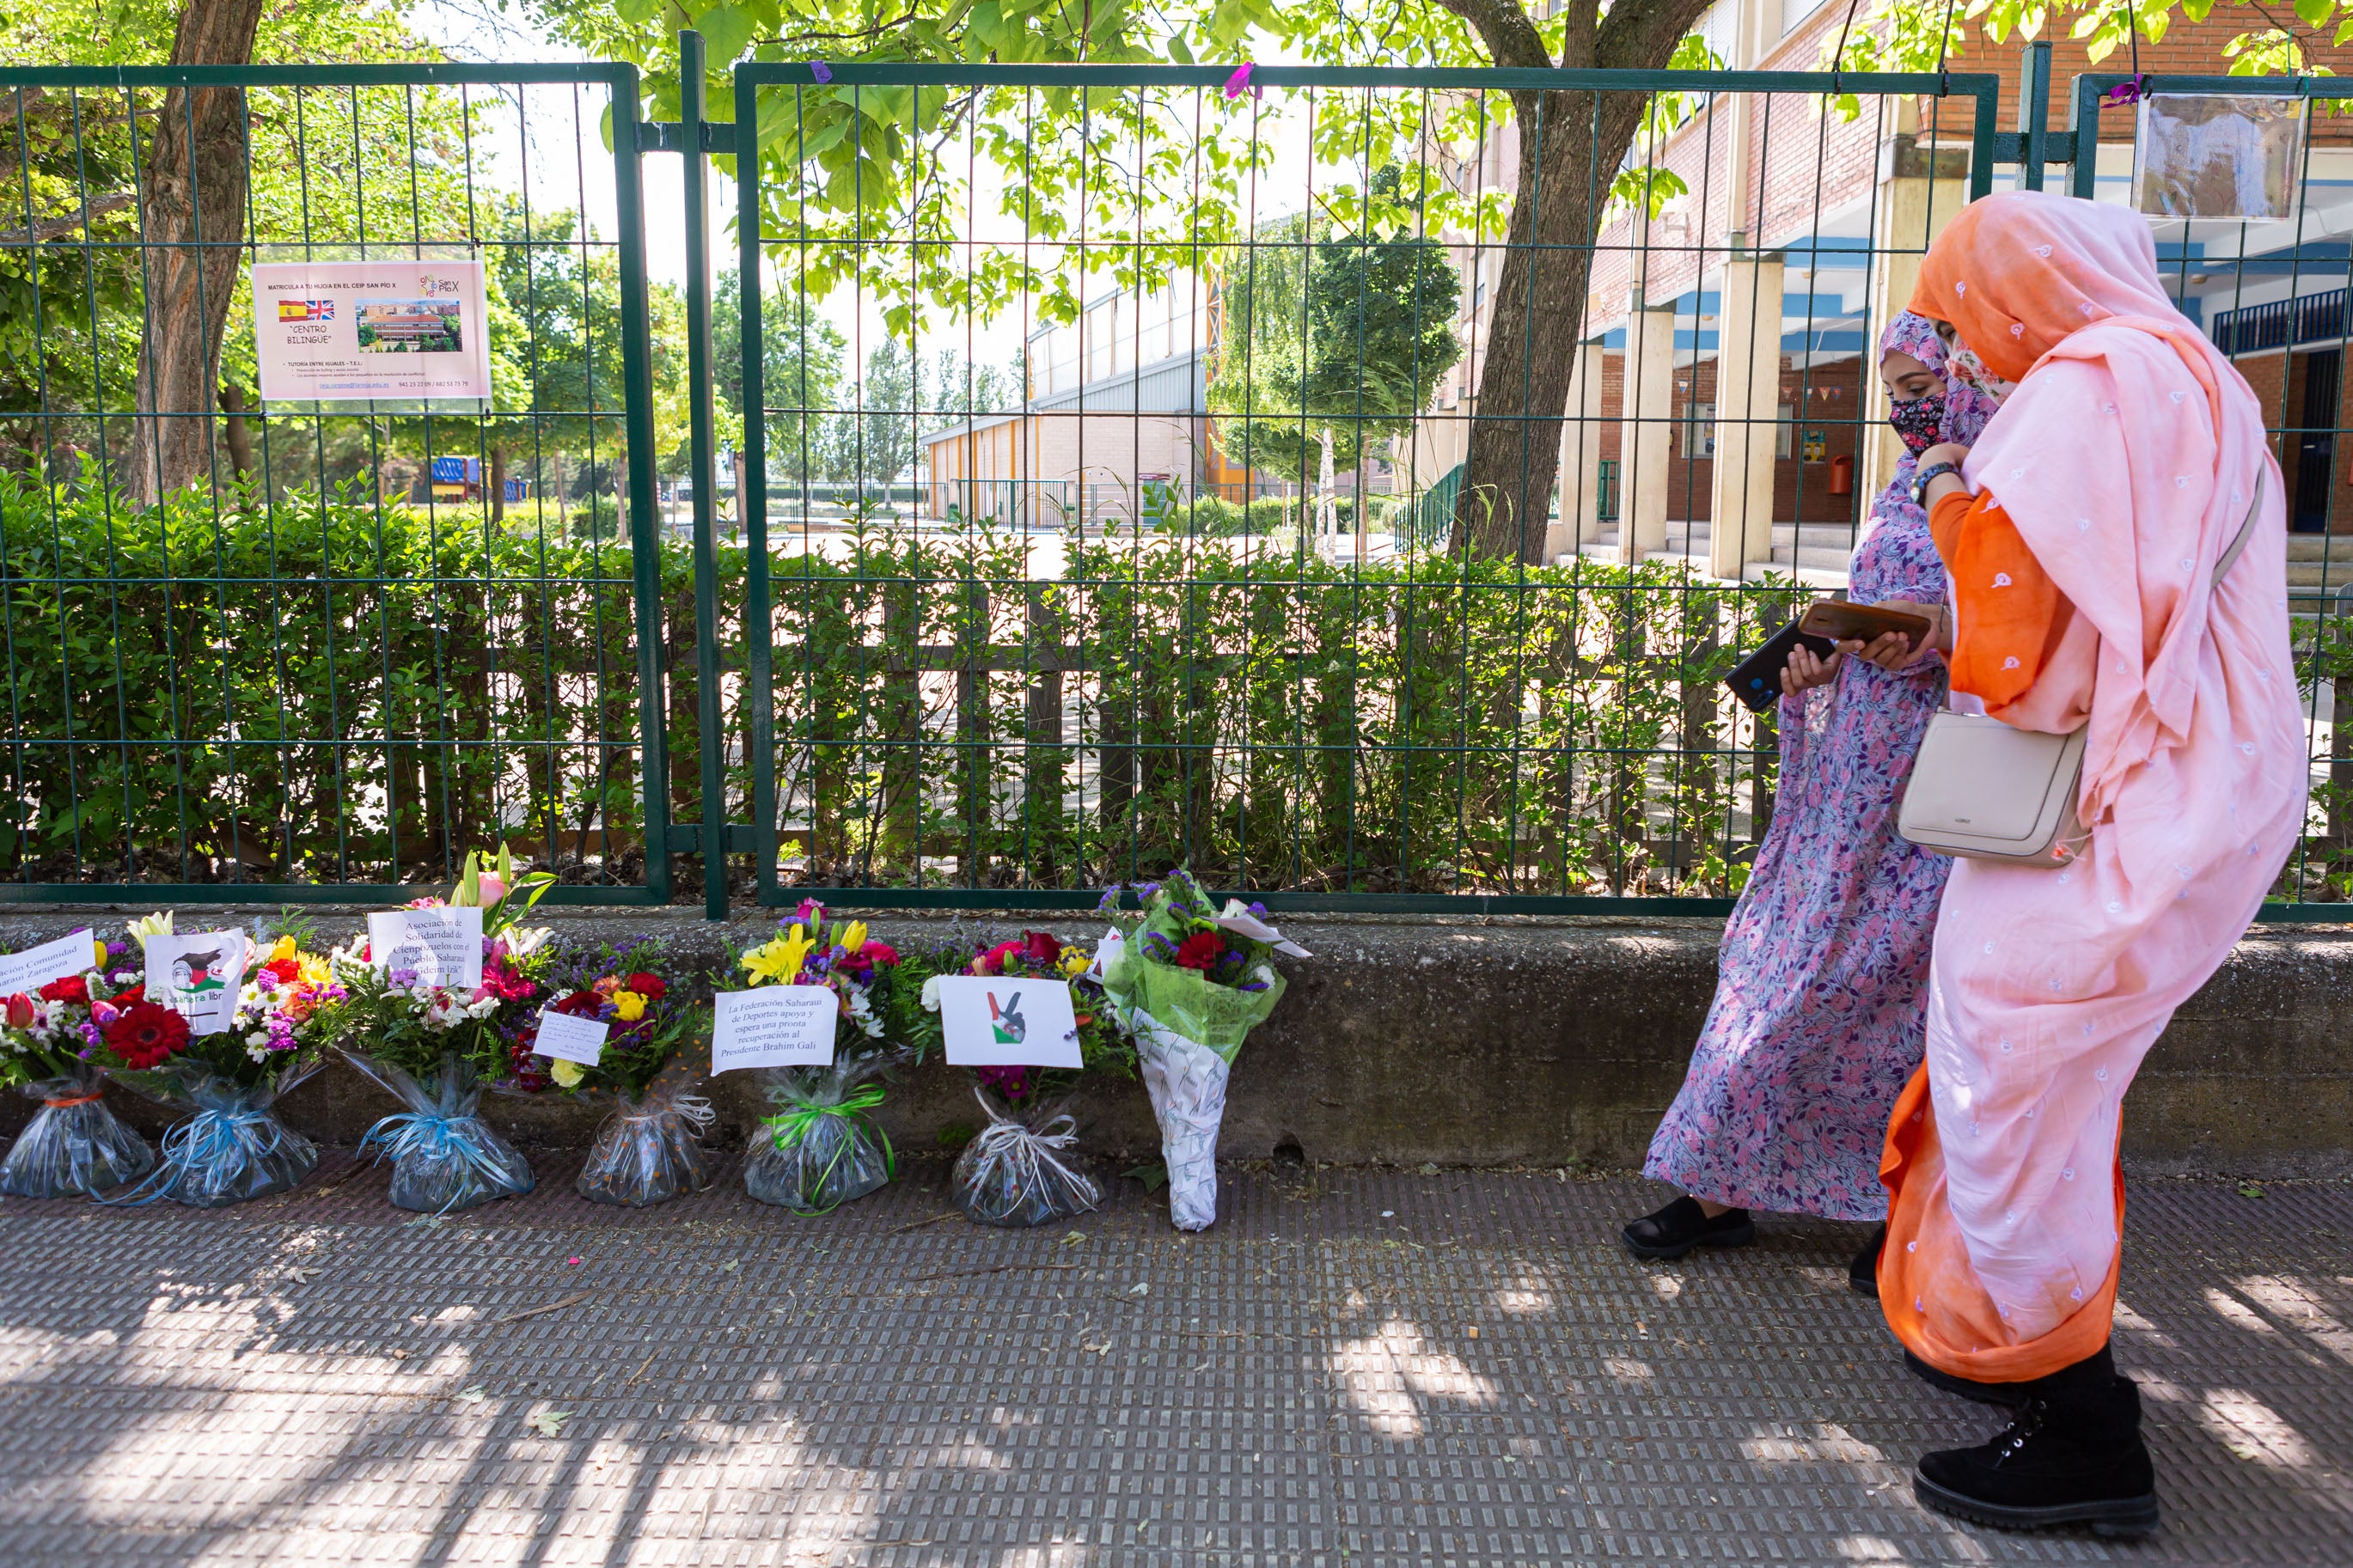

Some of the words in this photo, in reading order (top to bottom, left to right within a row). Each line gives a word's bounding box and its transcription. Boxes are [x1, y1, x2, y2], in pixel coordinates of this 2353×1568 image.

[452, 281, 459, 293] X
[405, 918, 454, 930] Asociación
[455, 918, 462, 927] de
[405, 930, 455, 942] Solidaridad
[455, 930, 463, 939] de
[464, 942, 470, 951] el
[26, 945, 77, 968] Comunidad
[403, 954, 435, 965] Pueblo
[437, 953, 466, 962] Saharaui
[27, 959, 68, 979] Zaragoza
[728, 1004, 738, 1014] La
[739, 998, 783, 1012] Federación
[785, 997, 822, 1008] Saharaui
[731, 1015, 742, 1023] de
[743, 1010, 778, 1023] Deportes
[779, 1010, 806, 1020] apoya
[807, 1010, 815, 1018] y
[735, 1024, 761, 1034] espera
[762, 1022, 777, 1030] una
[779, 1021, 806, 1030] pronta
[737, 1031, 789, 1045] recuperación
[791, 1029, 800, 1039] al
[720, 1045, 761, 1058] Presidente
[762, 1042, 795, 1052] Brahim
[797, 1040, 817, 1051] Gali
